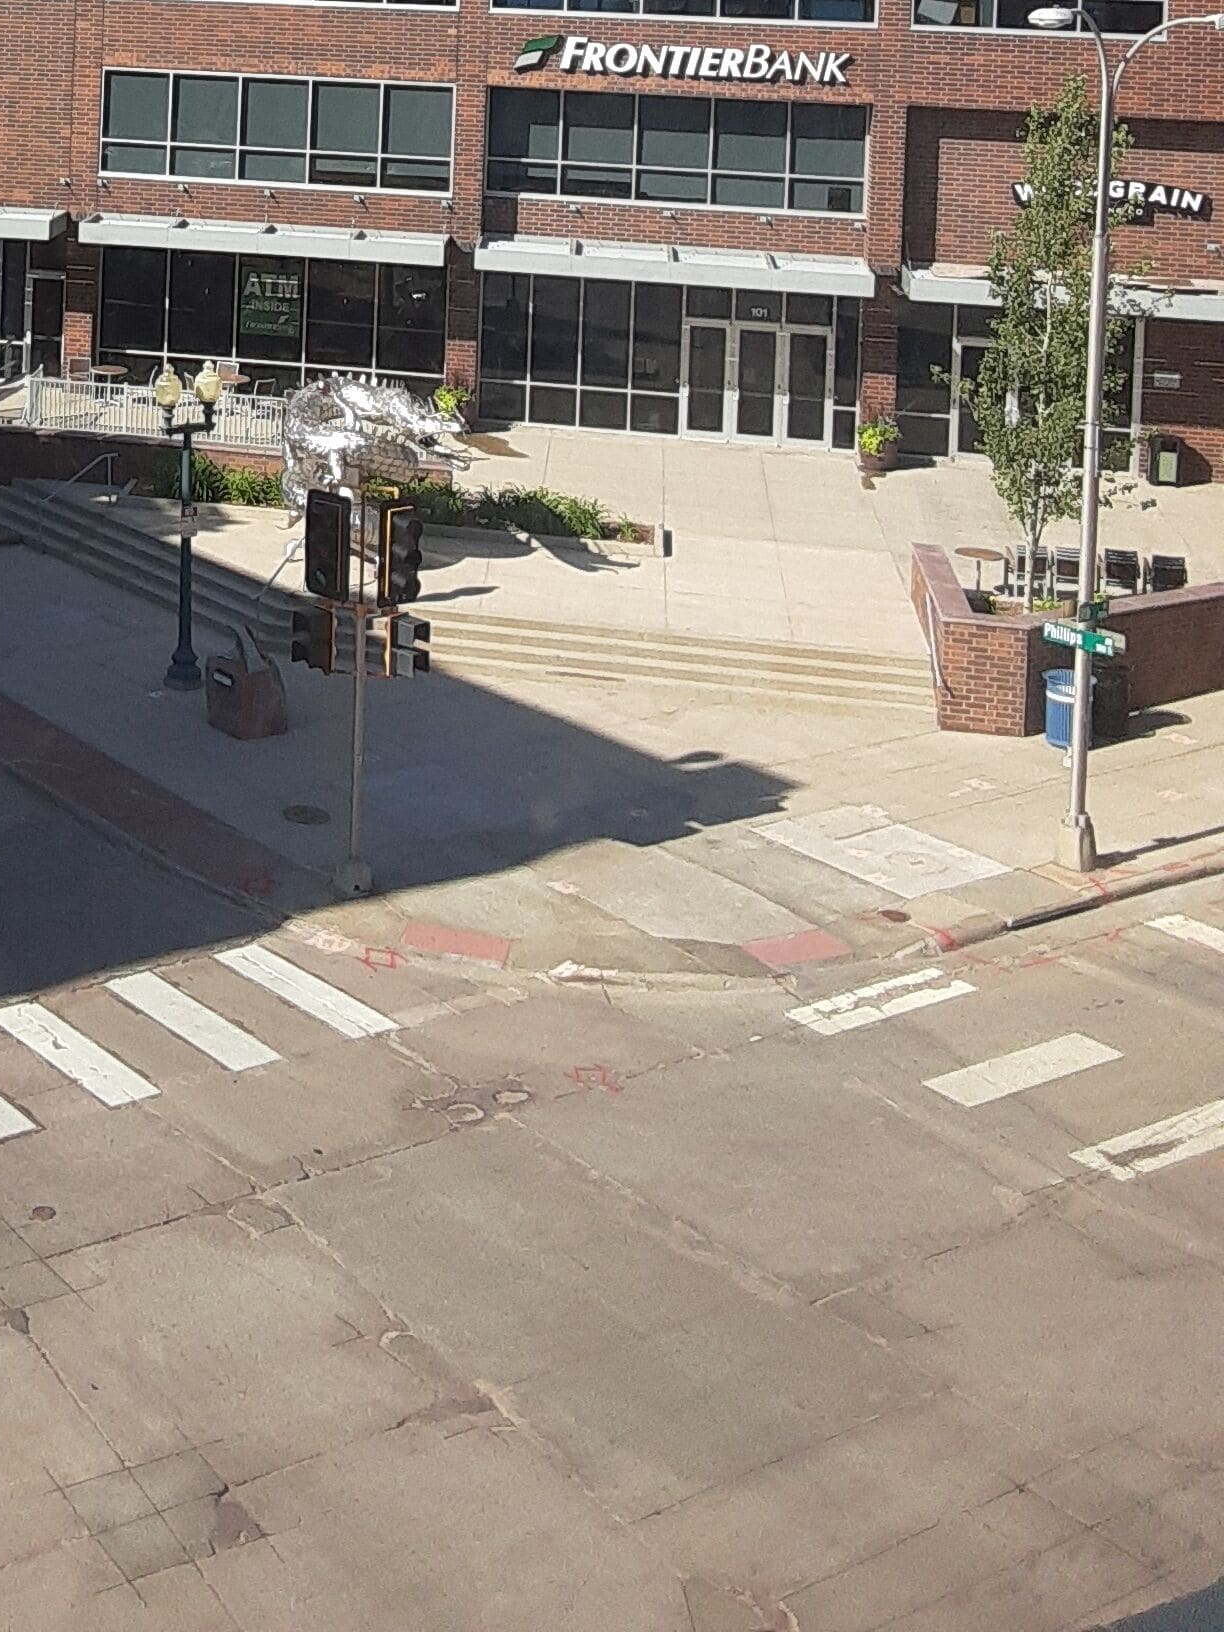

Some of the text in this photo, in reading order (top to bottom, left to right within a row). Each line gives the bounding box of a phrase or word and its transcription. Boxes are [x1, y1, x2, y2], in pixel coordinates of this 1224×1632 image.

[559, 36, 851, 83] FRONTIERBANK
[1014, 178, 1204, 213] WGRAIN
[243, 272, 300, 298] ATM
[250, 299, 291, 313] INSIDE
[750, 307, 768, 317] 101
[1044, 622, 1083, 647] Phillips
